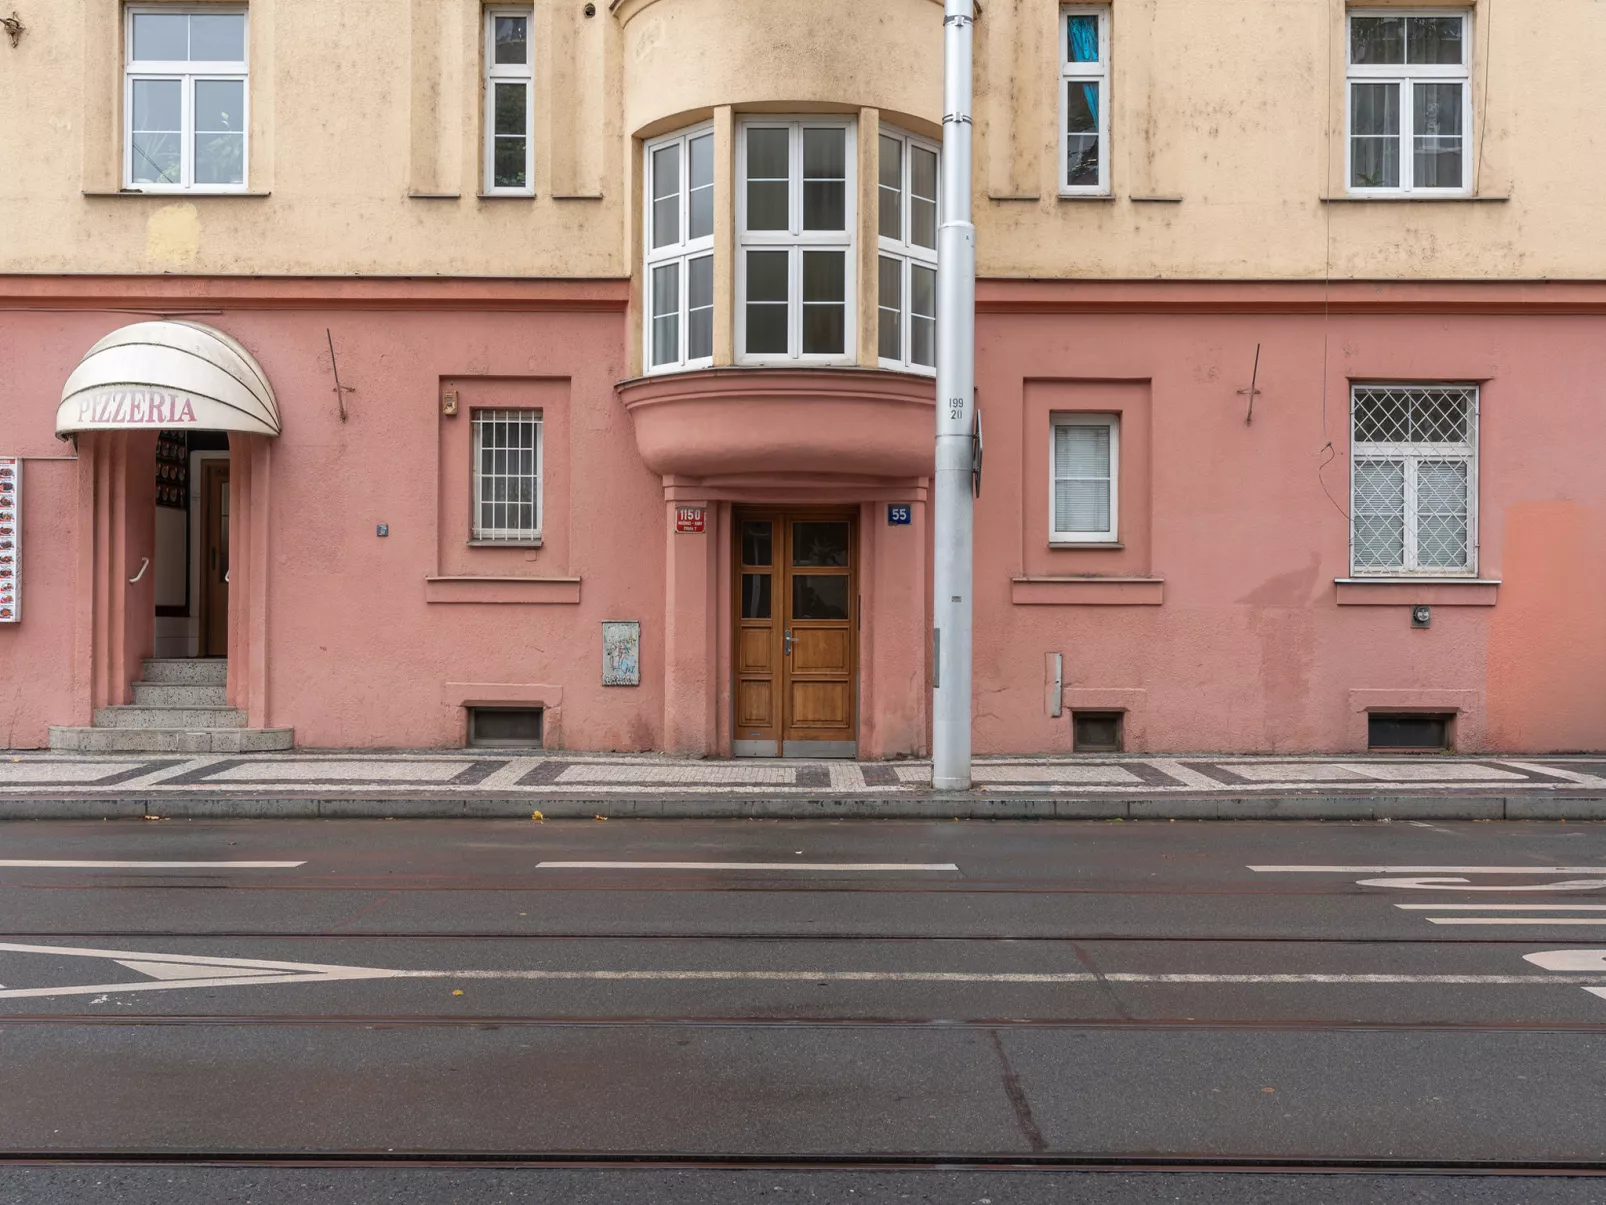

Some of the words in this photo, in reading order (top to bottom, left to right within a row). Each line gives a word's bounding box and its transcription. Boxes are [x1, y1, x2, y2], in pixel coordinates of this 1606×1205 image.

[77, 389, 198, 424] PIZZERIA
[949, 398, 964, 408] 199
[680, 509, 700, 521] 1150
[892, 508, 907, 521] 55
